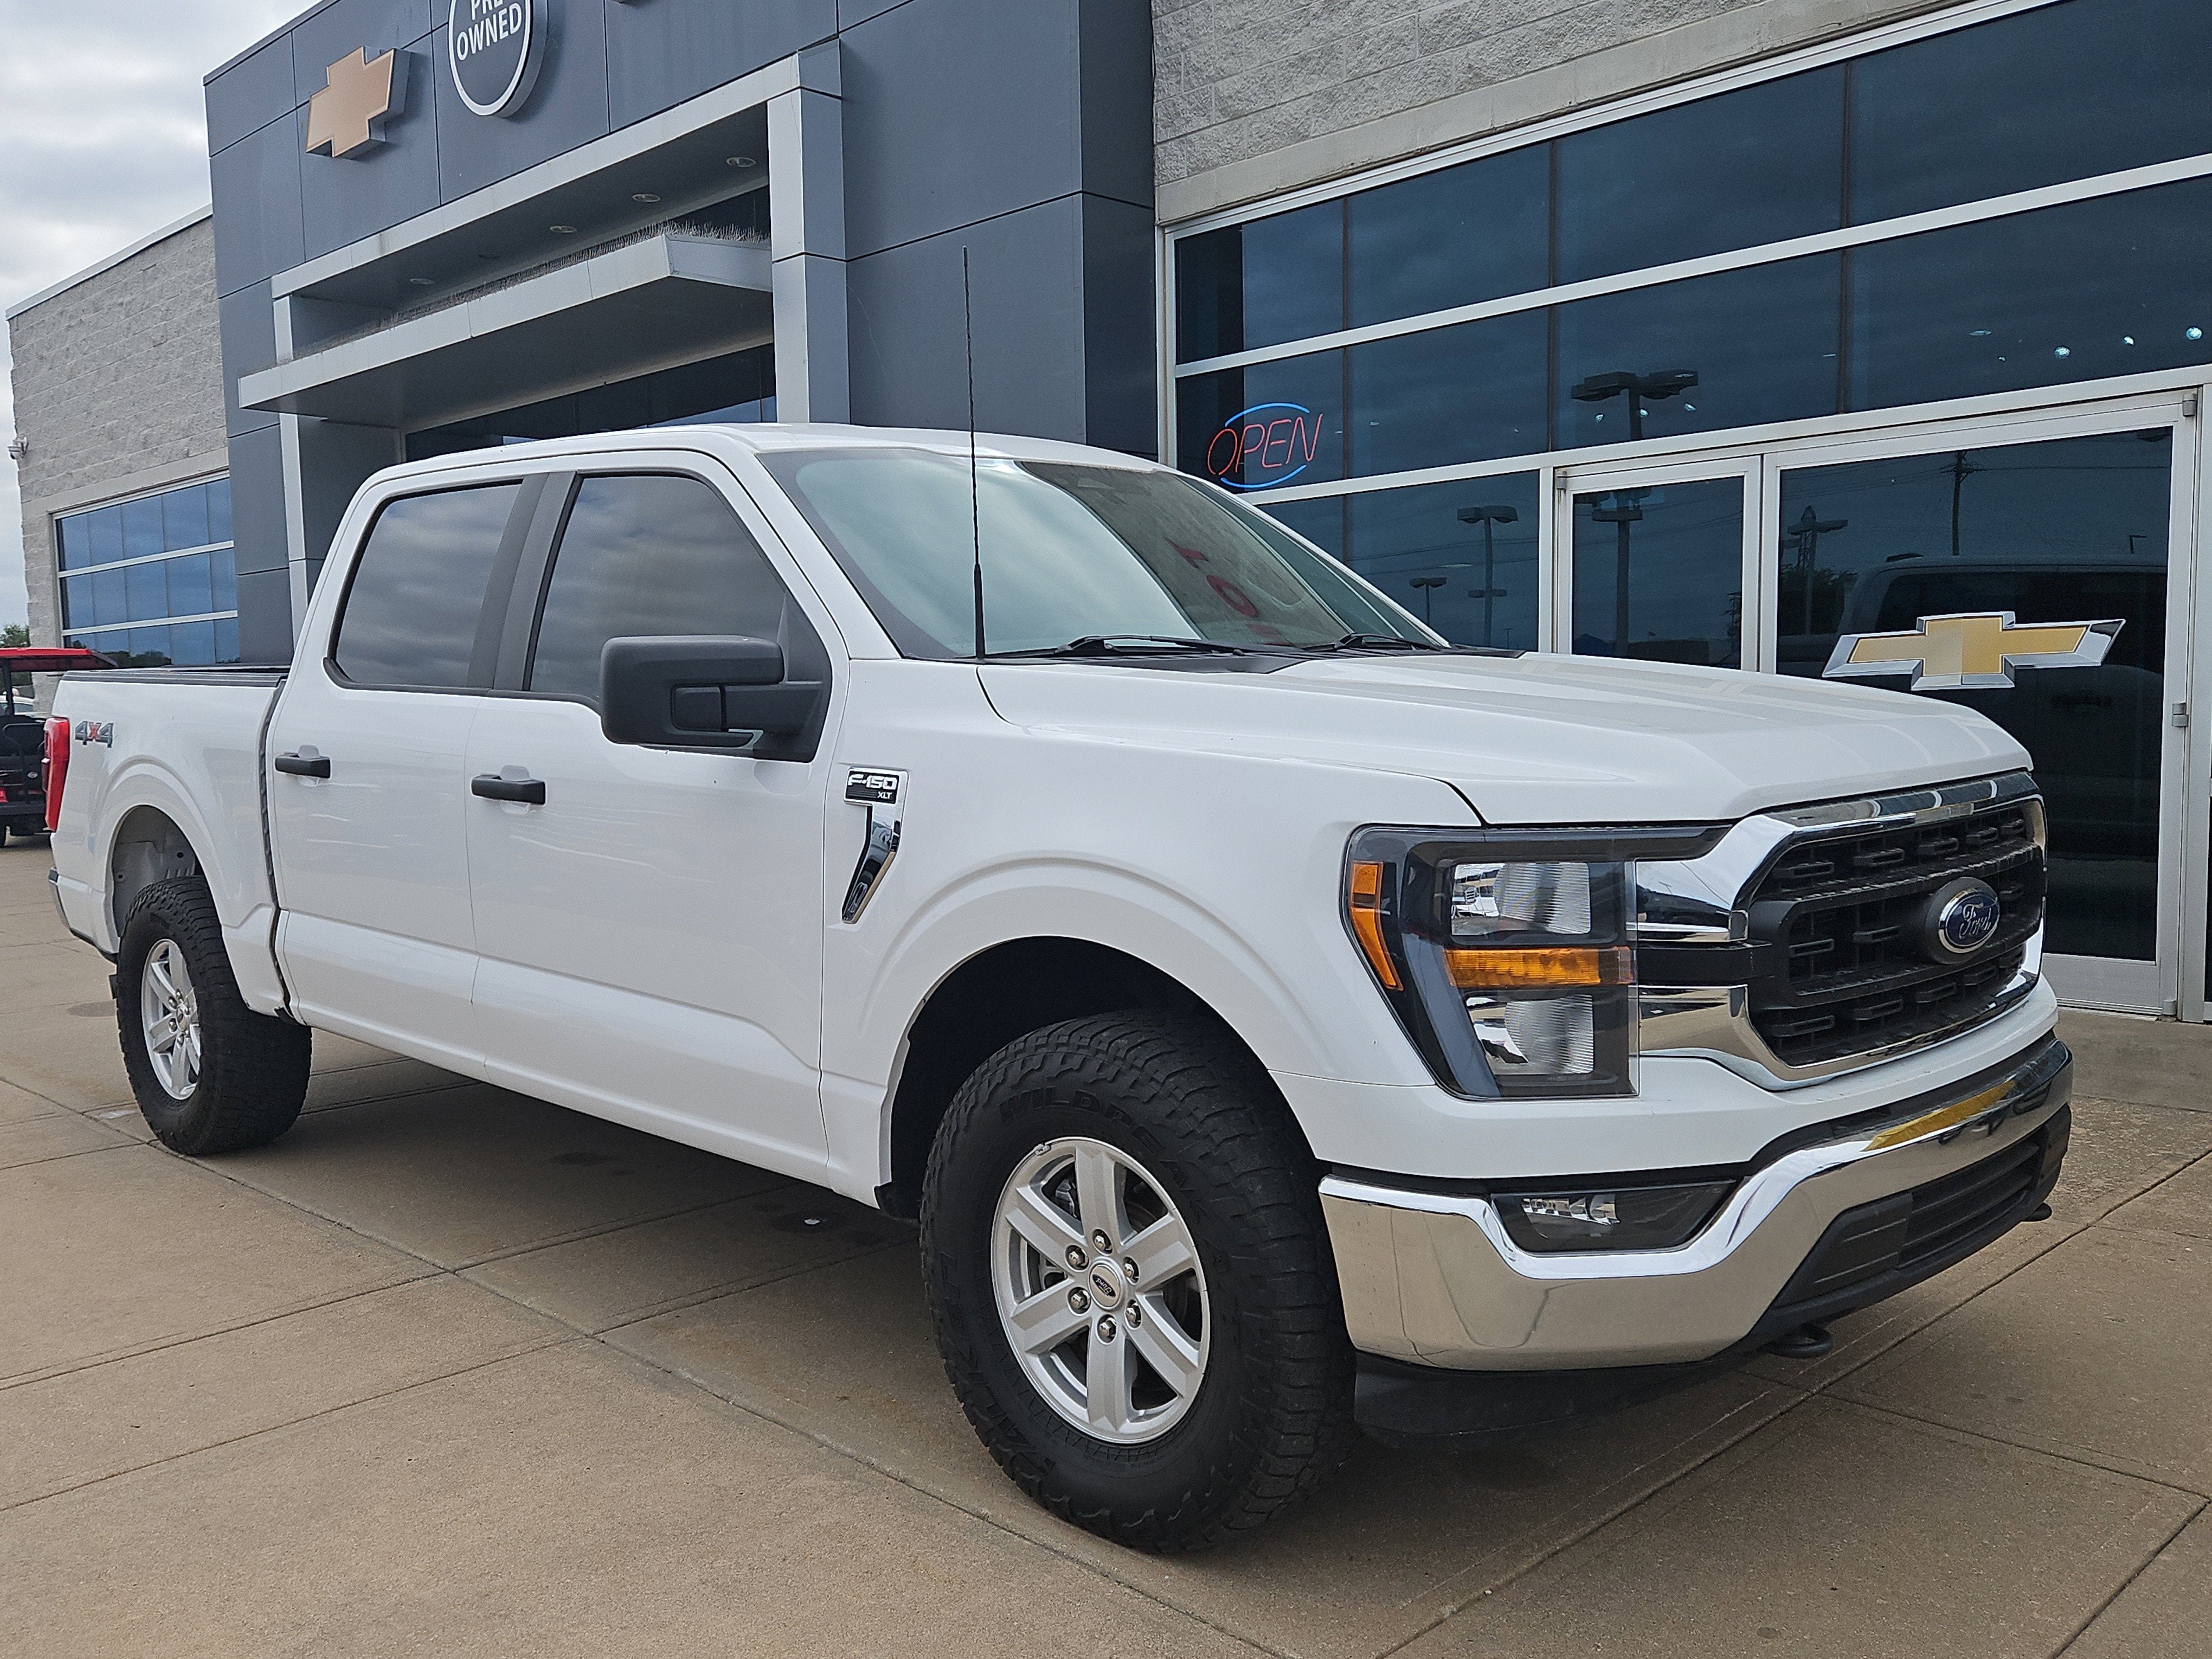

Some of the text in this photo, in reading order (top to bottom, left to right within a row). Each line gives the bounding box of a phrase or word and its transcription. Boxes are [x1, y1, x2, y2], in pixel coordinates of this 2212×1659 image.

[456, 3, 522, 61] OWNED
[1207, 413, 1323, 475] OPEN
[847, 774, 898, 790] F-150
[877, 791, 892, 799] XLT
[1958, 902, 1992, 940] Ford
